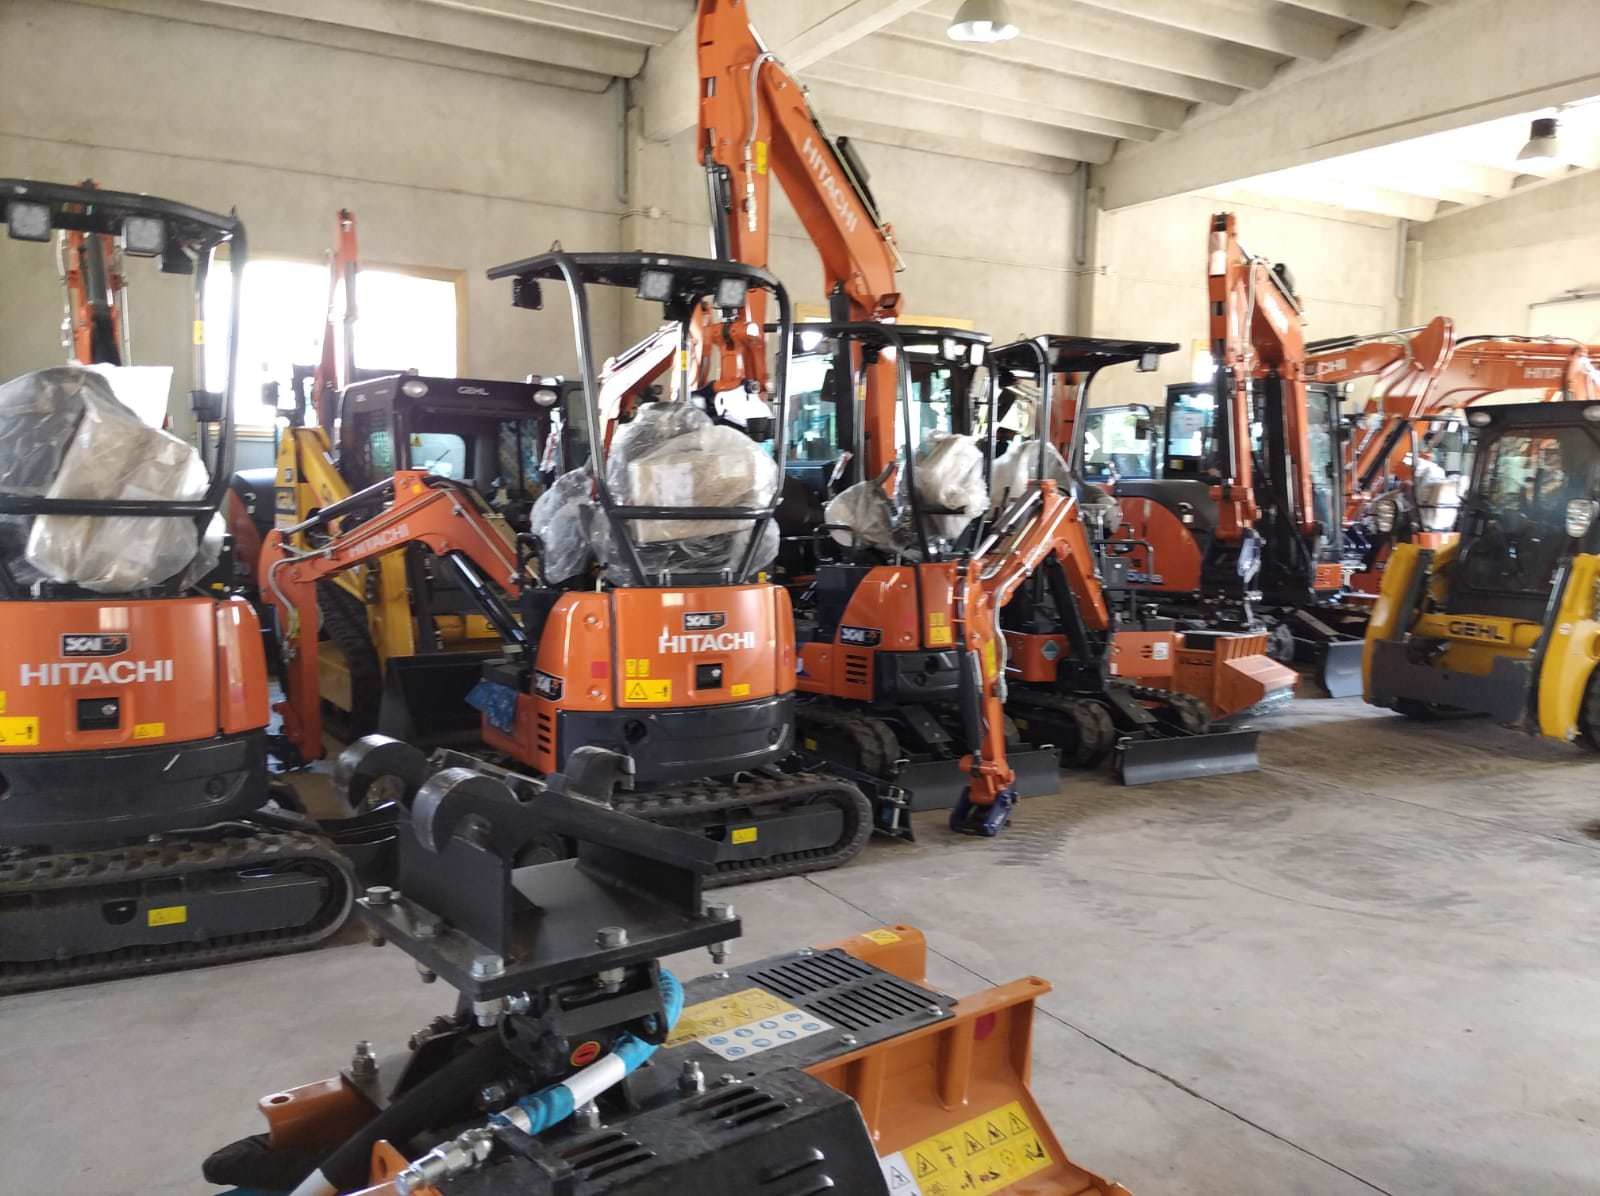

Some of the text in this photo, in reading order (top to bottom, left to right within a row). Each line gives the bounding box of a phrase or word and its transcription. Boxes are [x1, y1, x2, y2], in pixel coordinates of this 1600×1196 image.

[1449, 621, 1505, 640] GEHL
[658, 632, 755, 654] HITACHI
[20, 660, 173, 686] HITACHI
